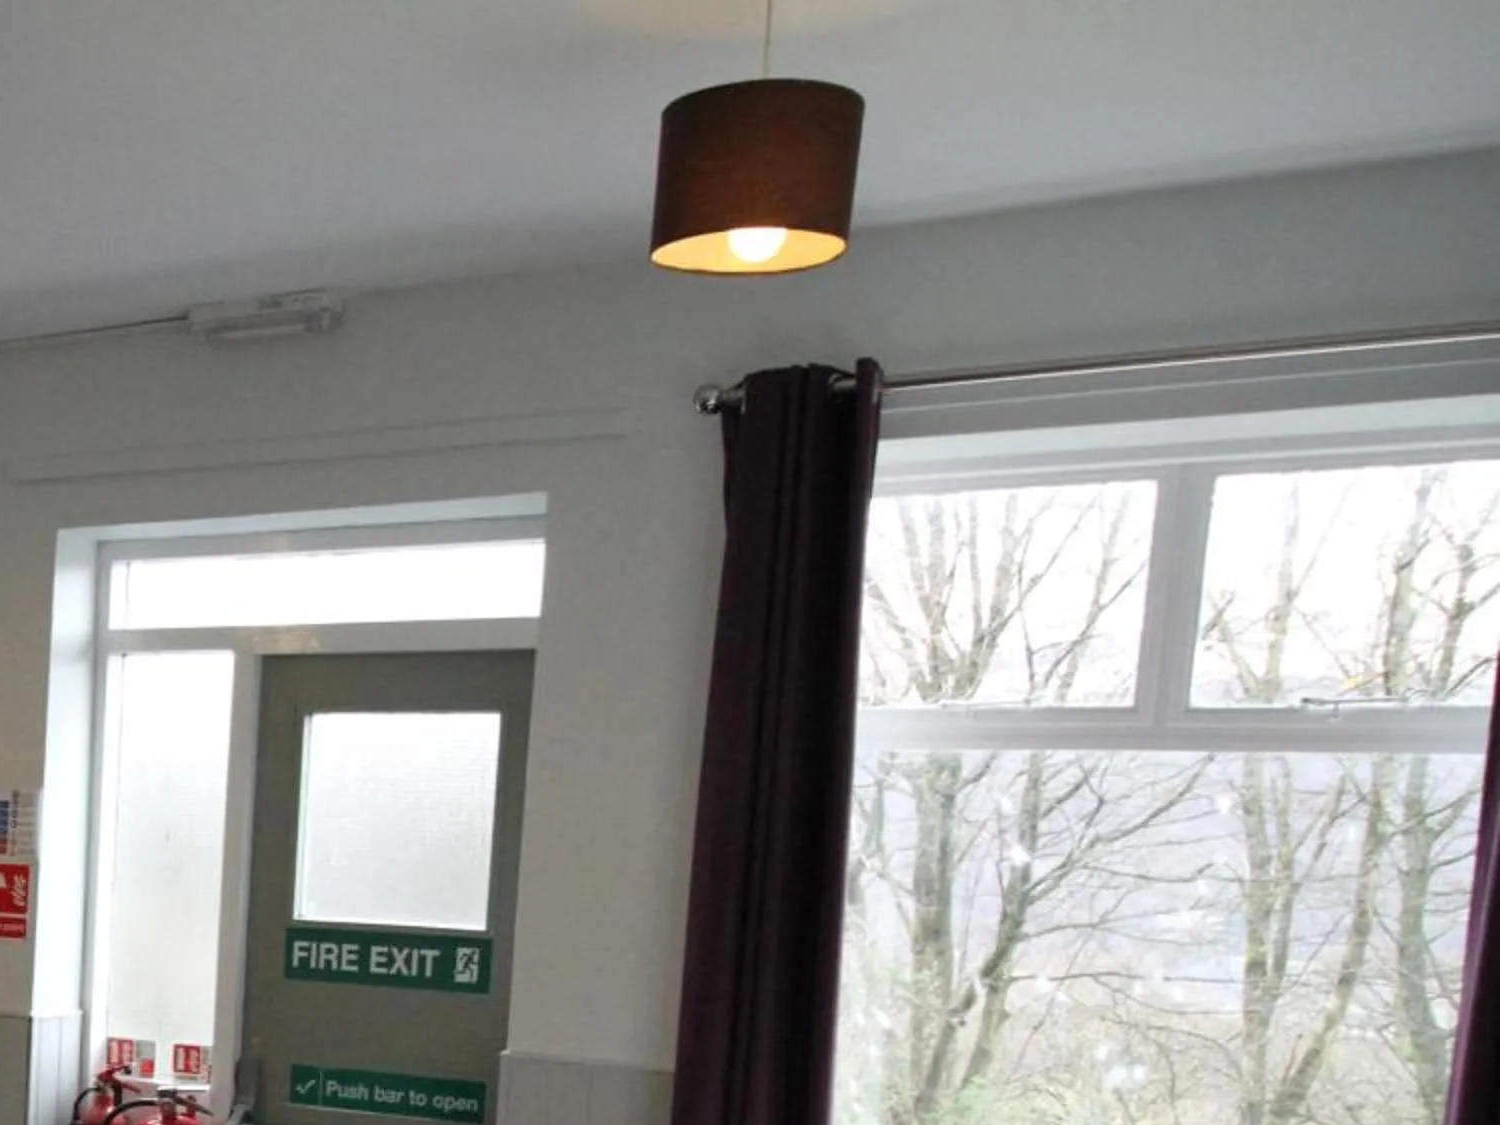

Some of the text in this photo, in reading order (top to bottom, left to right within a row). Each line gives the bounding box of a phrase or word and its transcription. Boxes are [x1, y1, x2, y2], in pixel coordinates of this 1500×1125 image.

[292, 941, 440, 978] FIRE EXIT
[326, 1079, 479, 1115] Push bar to open
